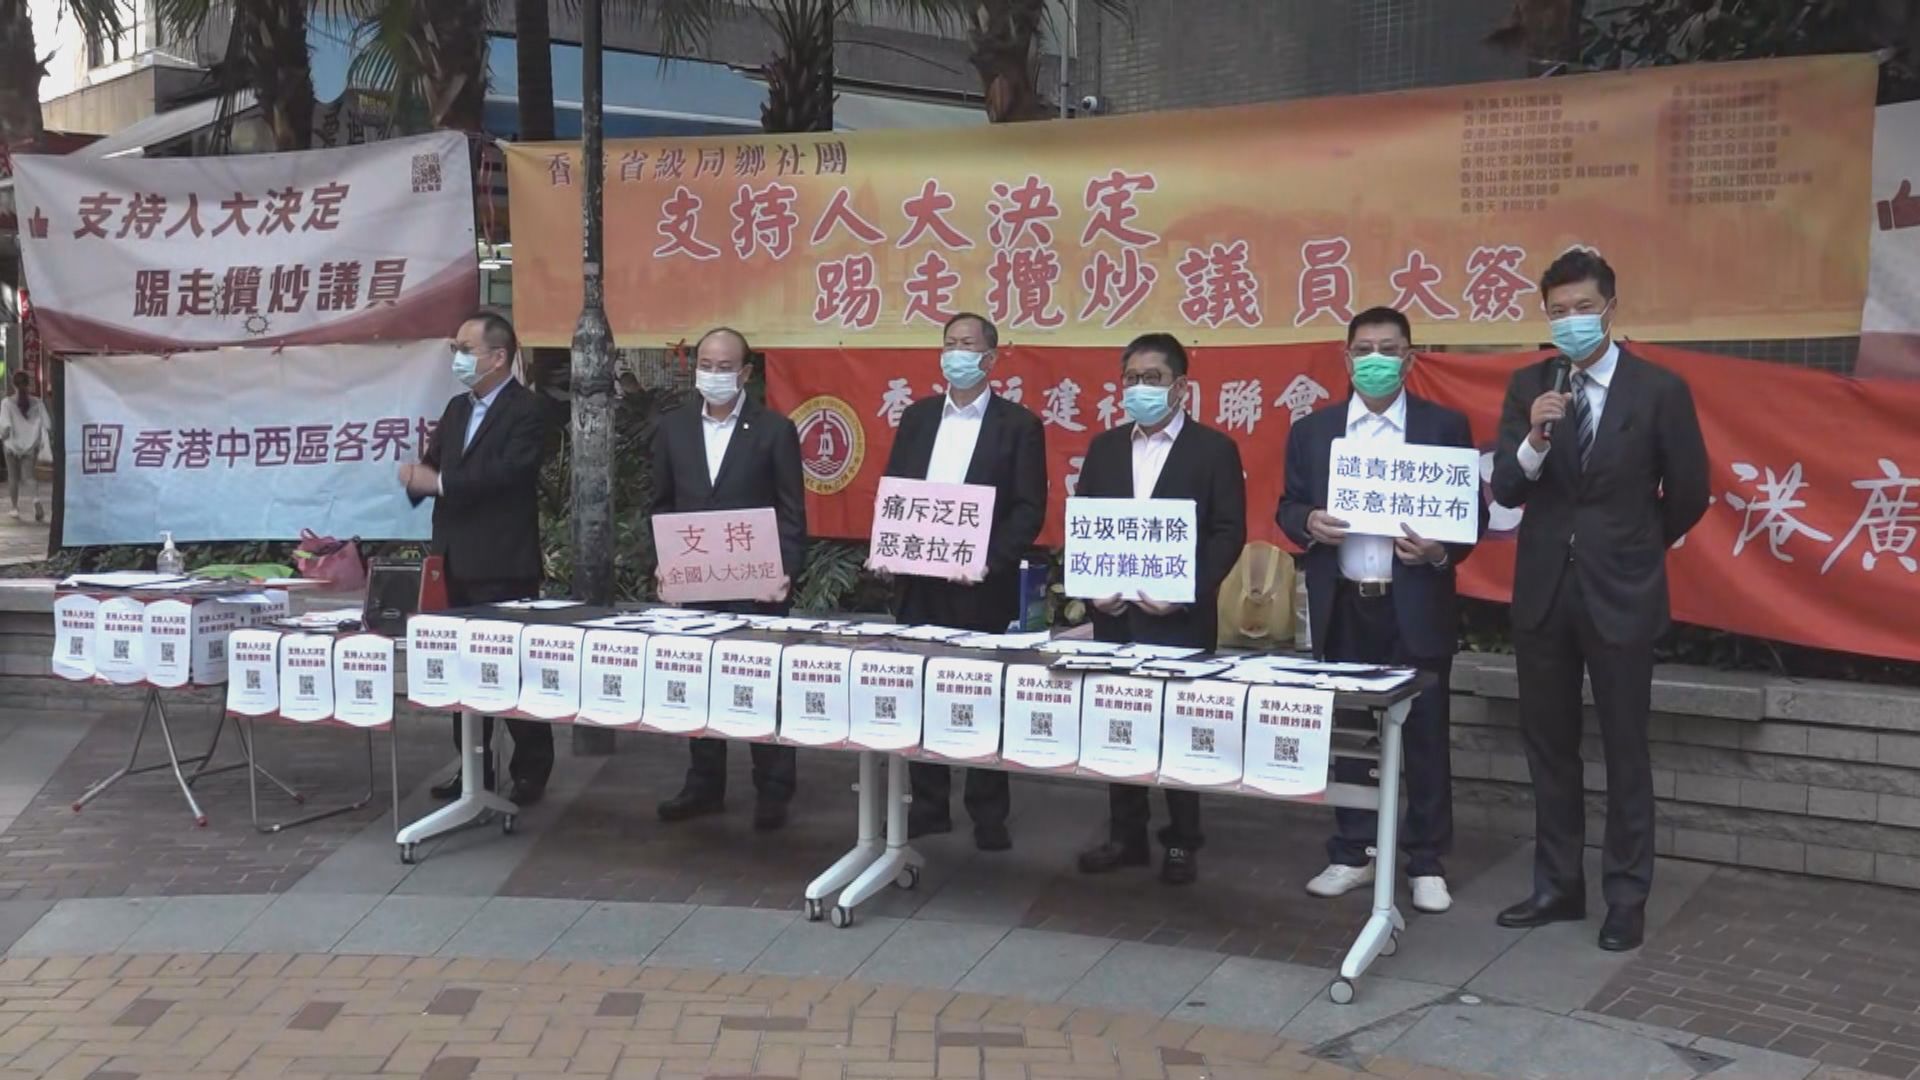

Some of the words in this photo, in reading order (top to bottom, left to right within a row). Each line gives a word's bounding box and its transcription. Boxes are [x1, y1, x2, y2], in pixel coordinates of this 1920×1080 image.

[546, 141, 848, 186] 香省級同鄉社團
[74, 181, 350, 240] 支持人大決定
[653, 170, 1159, 260] 支持人大決定
[134, 258, 407, 318] 踢走攬炒議員
[813, 237, 1600, 330] 踢走攬炒議員大簽
[1336, 455, 1472, 488] 譴責攬炒派
[881, 494, 980, 529] 痛斥泛民
[1334, 488, 1470, 522] 惡意搞拉布
[676, 522, 755, 556] 支持
[1070, 516, 1189, 543] 垃圾唔清除
[875, 532, 976, 566] 惡意拉布
[668, 562, 777, 585] 全國人大決定
[1069, 554, 1189, 579] 政府難施政
